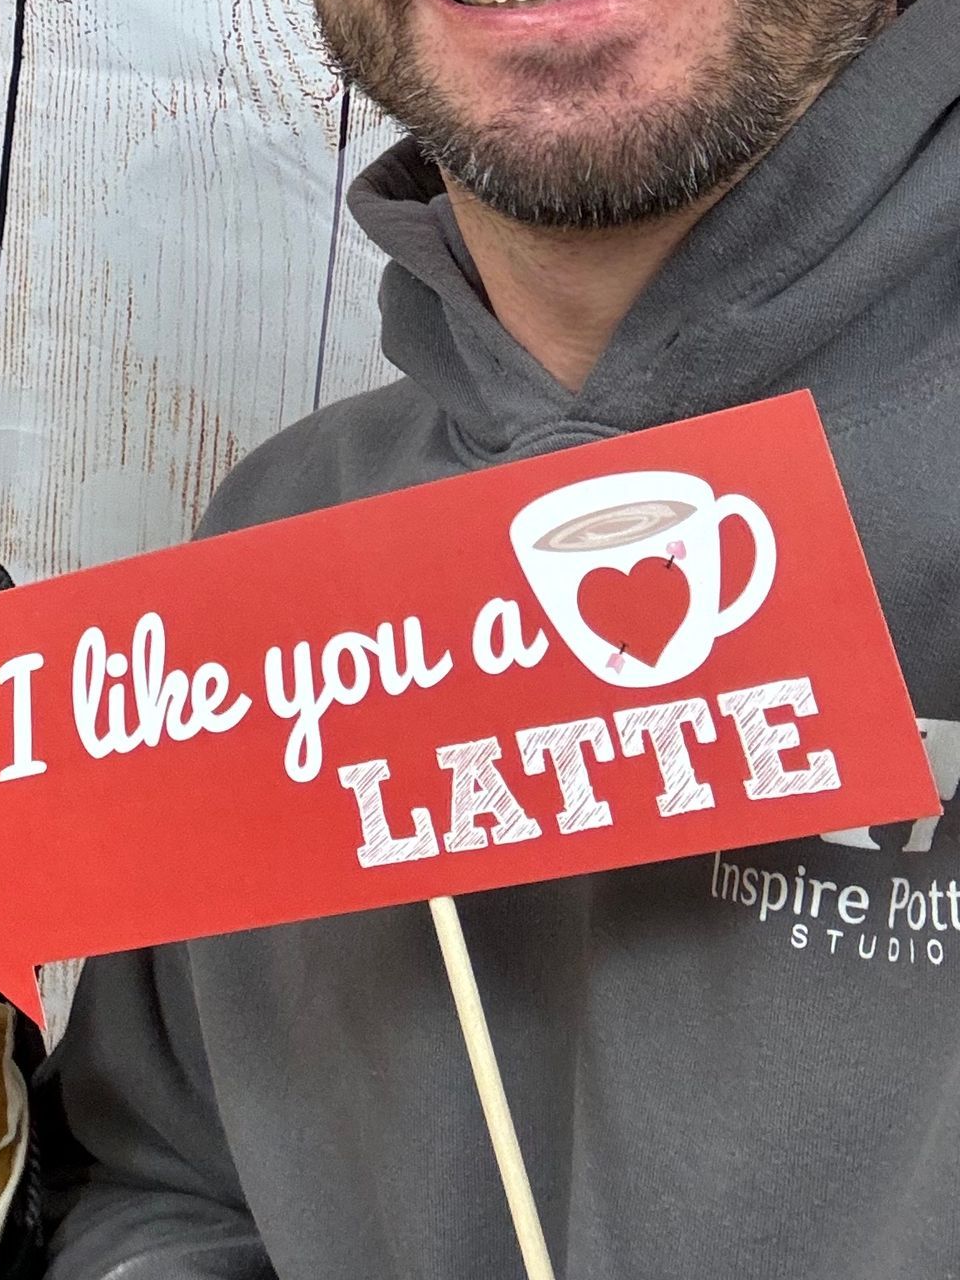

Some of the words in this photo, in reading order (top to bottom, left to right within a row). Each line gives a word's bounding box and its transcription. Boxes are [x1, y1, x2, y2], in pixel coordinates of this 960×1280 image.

[72, 611, 251, 758] like
[265, 615, 452, 782] you
[472, 599, 548, 675] a
[337, 677, 841, 868] LATTE
[711, 851, 870, 925] Inspire
[790, 923, 944, 965] STUDIO
